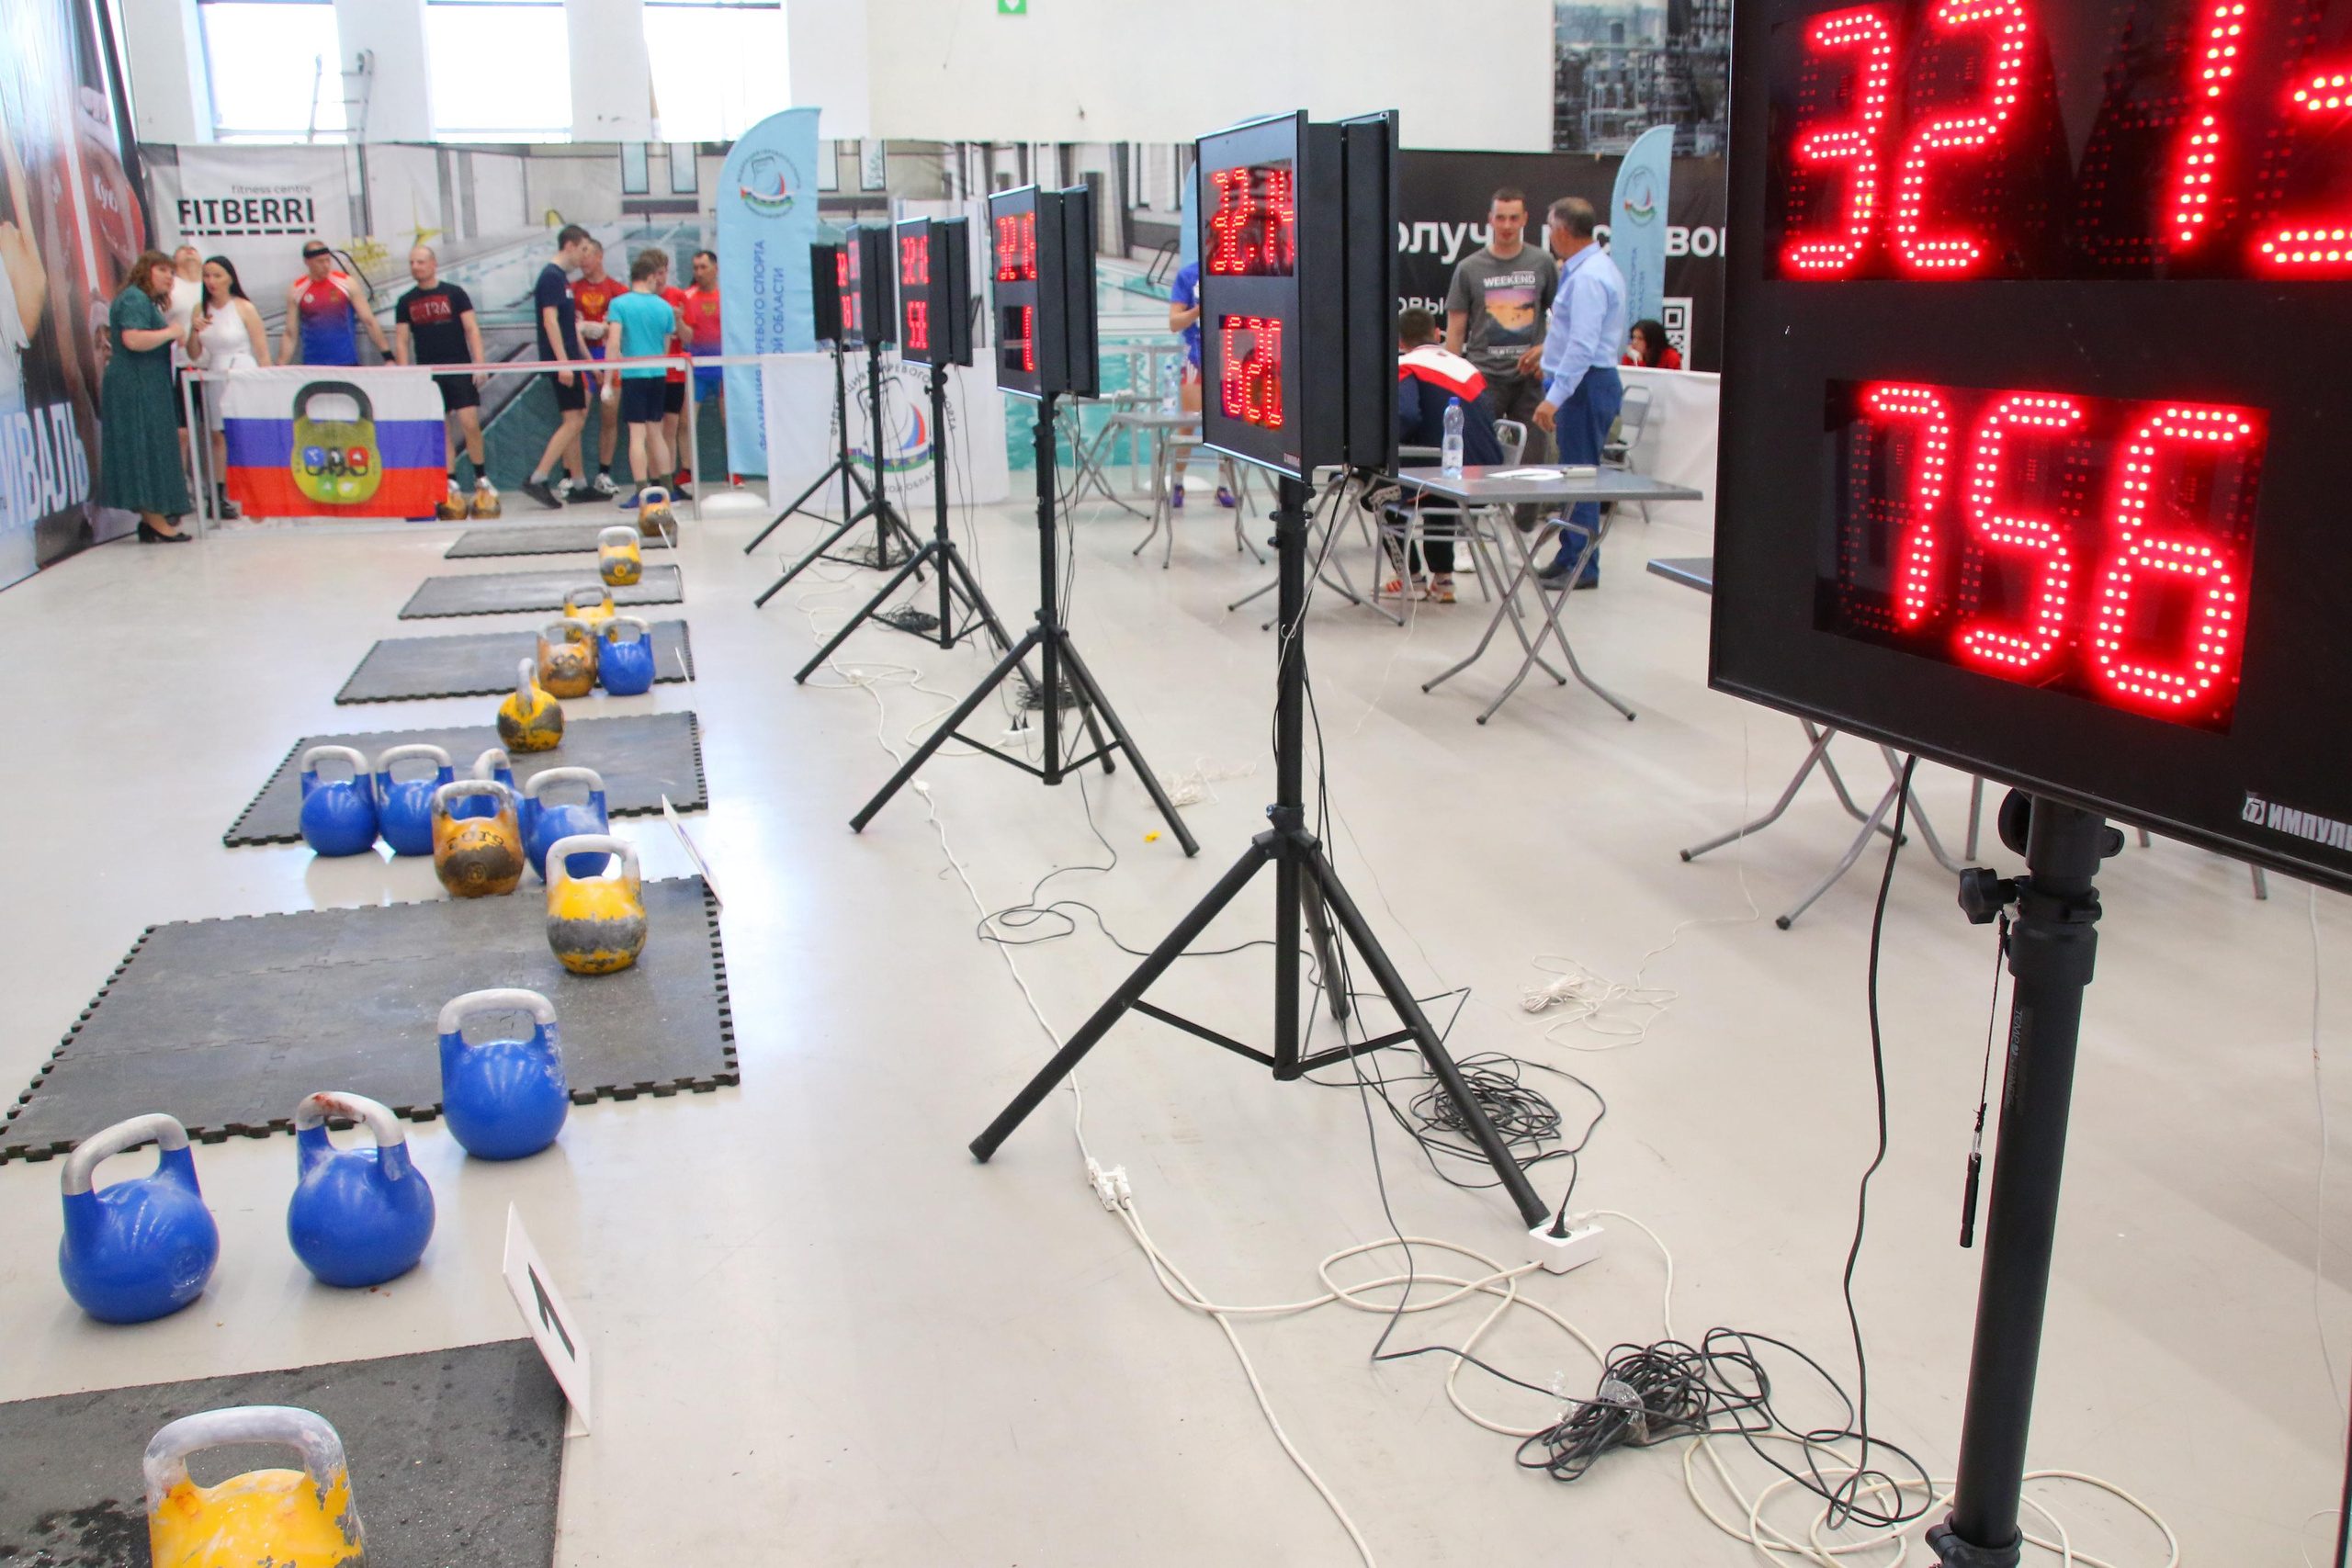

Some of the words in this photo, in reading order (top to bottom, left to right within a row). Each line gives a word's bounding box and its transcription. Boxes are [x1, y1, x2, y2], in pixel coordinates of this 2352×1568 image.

[177, 198, 314, 225] FITBERRI
[232, 185, 271, 194] fitness
[274, 186, 312, 194] centre
[1483, 275, 1536, 288] WEEKEND
[753, 298, 765, 355] РЕВОГО
[0, 401, 90, 528] ИВАЛЬ
[1868, 384, 2255, 708] 756
[527, 1261, 576, 1364] 1
